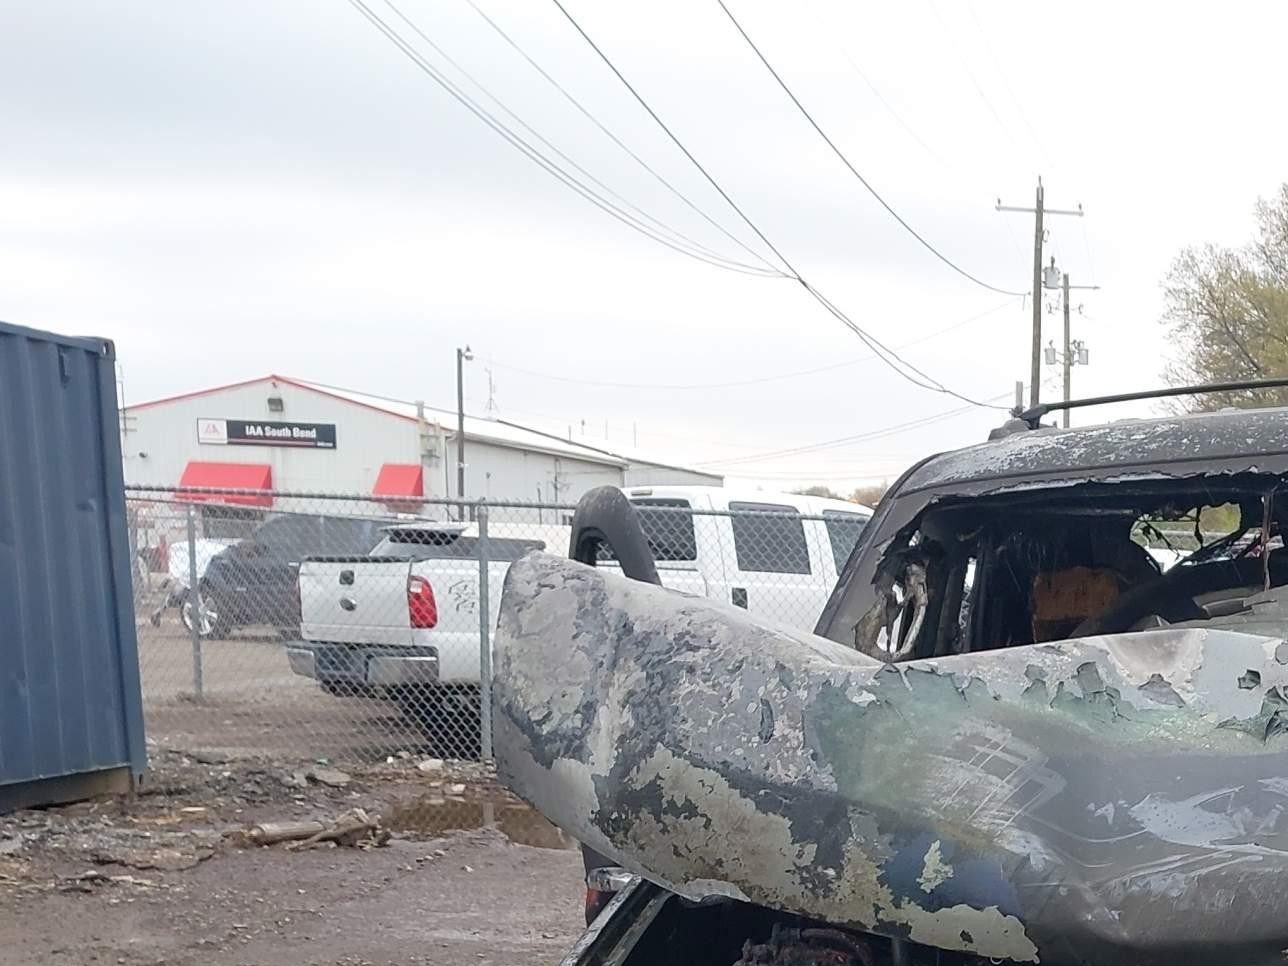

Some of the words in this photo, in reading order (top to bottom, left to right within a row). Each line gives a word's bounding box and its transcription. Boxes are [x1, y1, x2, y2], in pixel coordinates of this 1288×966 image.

[245, 425, 263, 436] IAA
[265, 426, 292, 437] South
[293, 427, 316, 438] Bend
